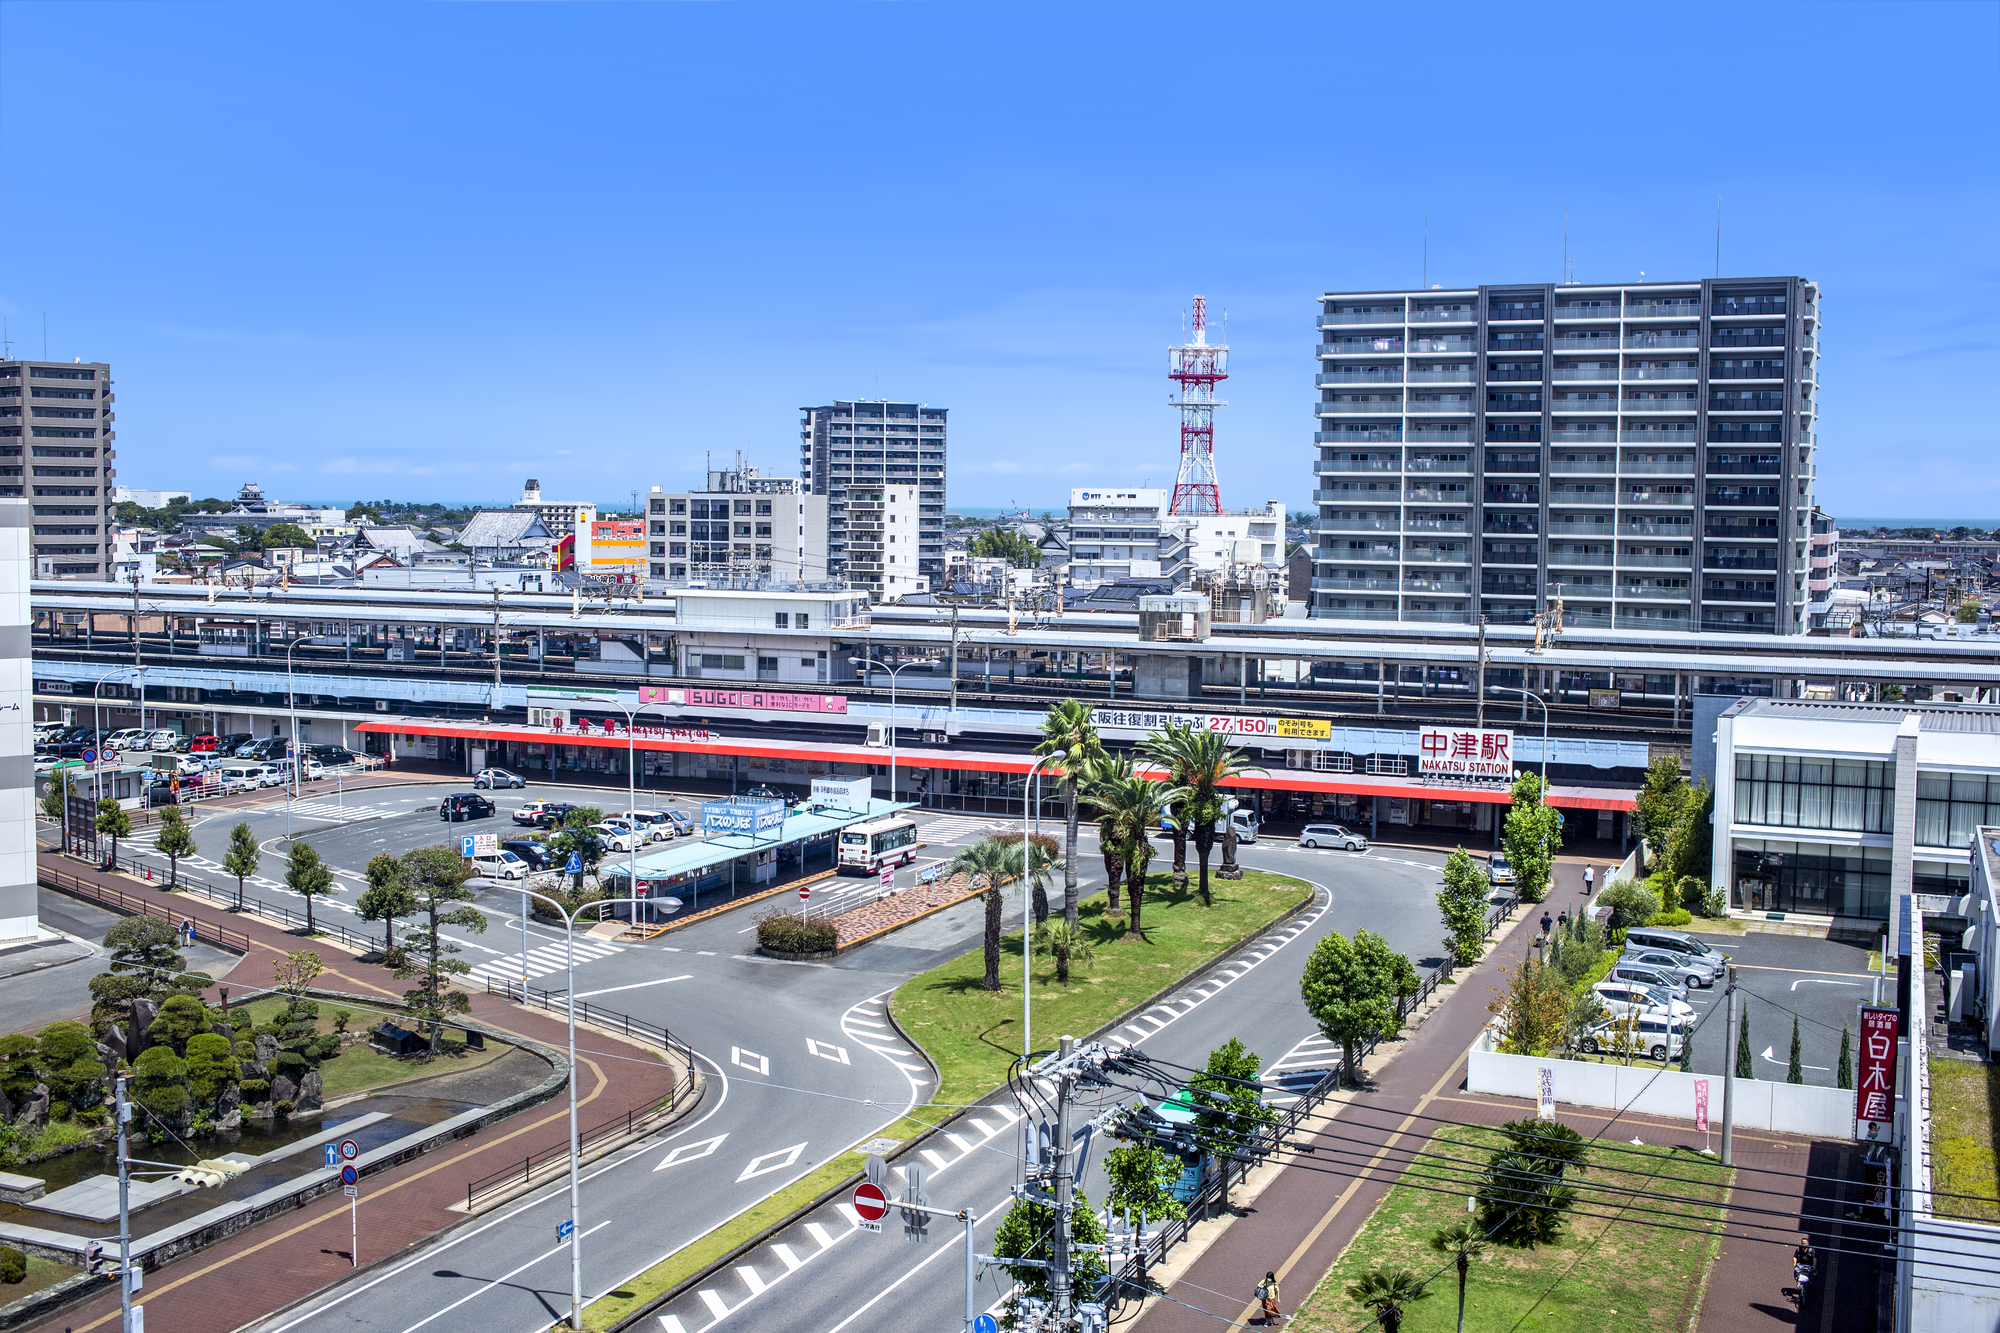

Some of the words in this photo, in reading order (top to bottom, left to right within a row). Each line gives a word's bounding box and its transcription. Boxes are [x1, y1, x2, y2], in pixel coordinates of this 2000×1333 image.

[693, 691, 763, 707] SUGOCA
[1278, 719, 1313, 728] のぞみ号も
[1284, 727, 1329, 737] 利用できます。
[1421, 729, 1510, 761] 中津駅
[1421, 759, 1466, 773] NAKATSU
[1468, 761, 1509, 774] STATION
[704, 814, 754, 830] バスのりば
[756, 810, 784, 831] バスのりば
[463, 837, 473, 854] P
[1863, 1011, 1898, 1022] 新しいタイプの
[1868, 1020, 1892, 1030] 居酒屋
[1862, 1030, 1891, 1120] 白木屋
[343, 1144, 355, 1156] 30
[859, 1223, 880, 1231] 一方通行
